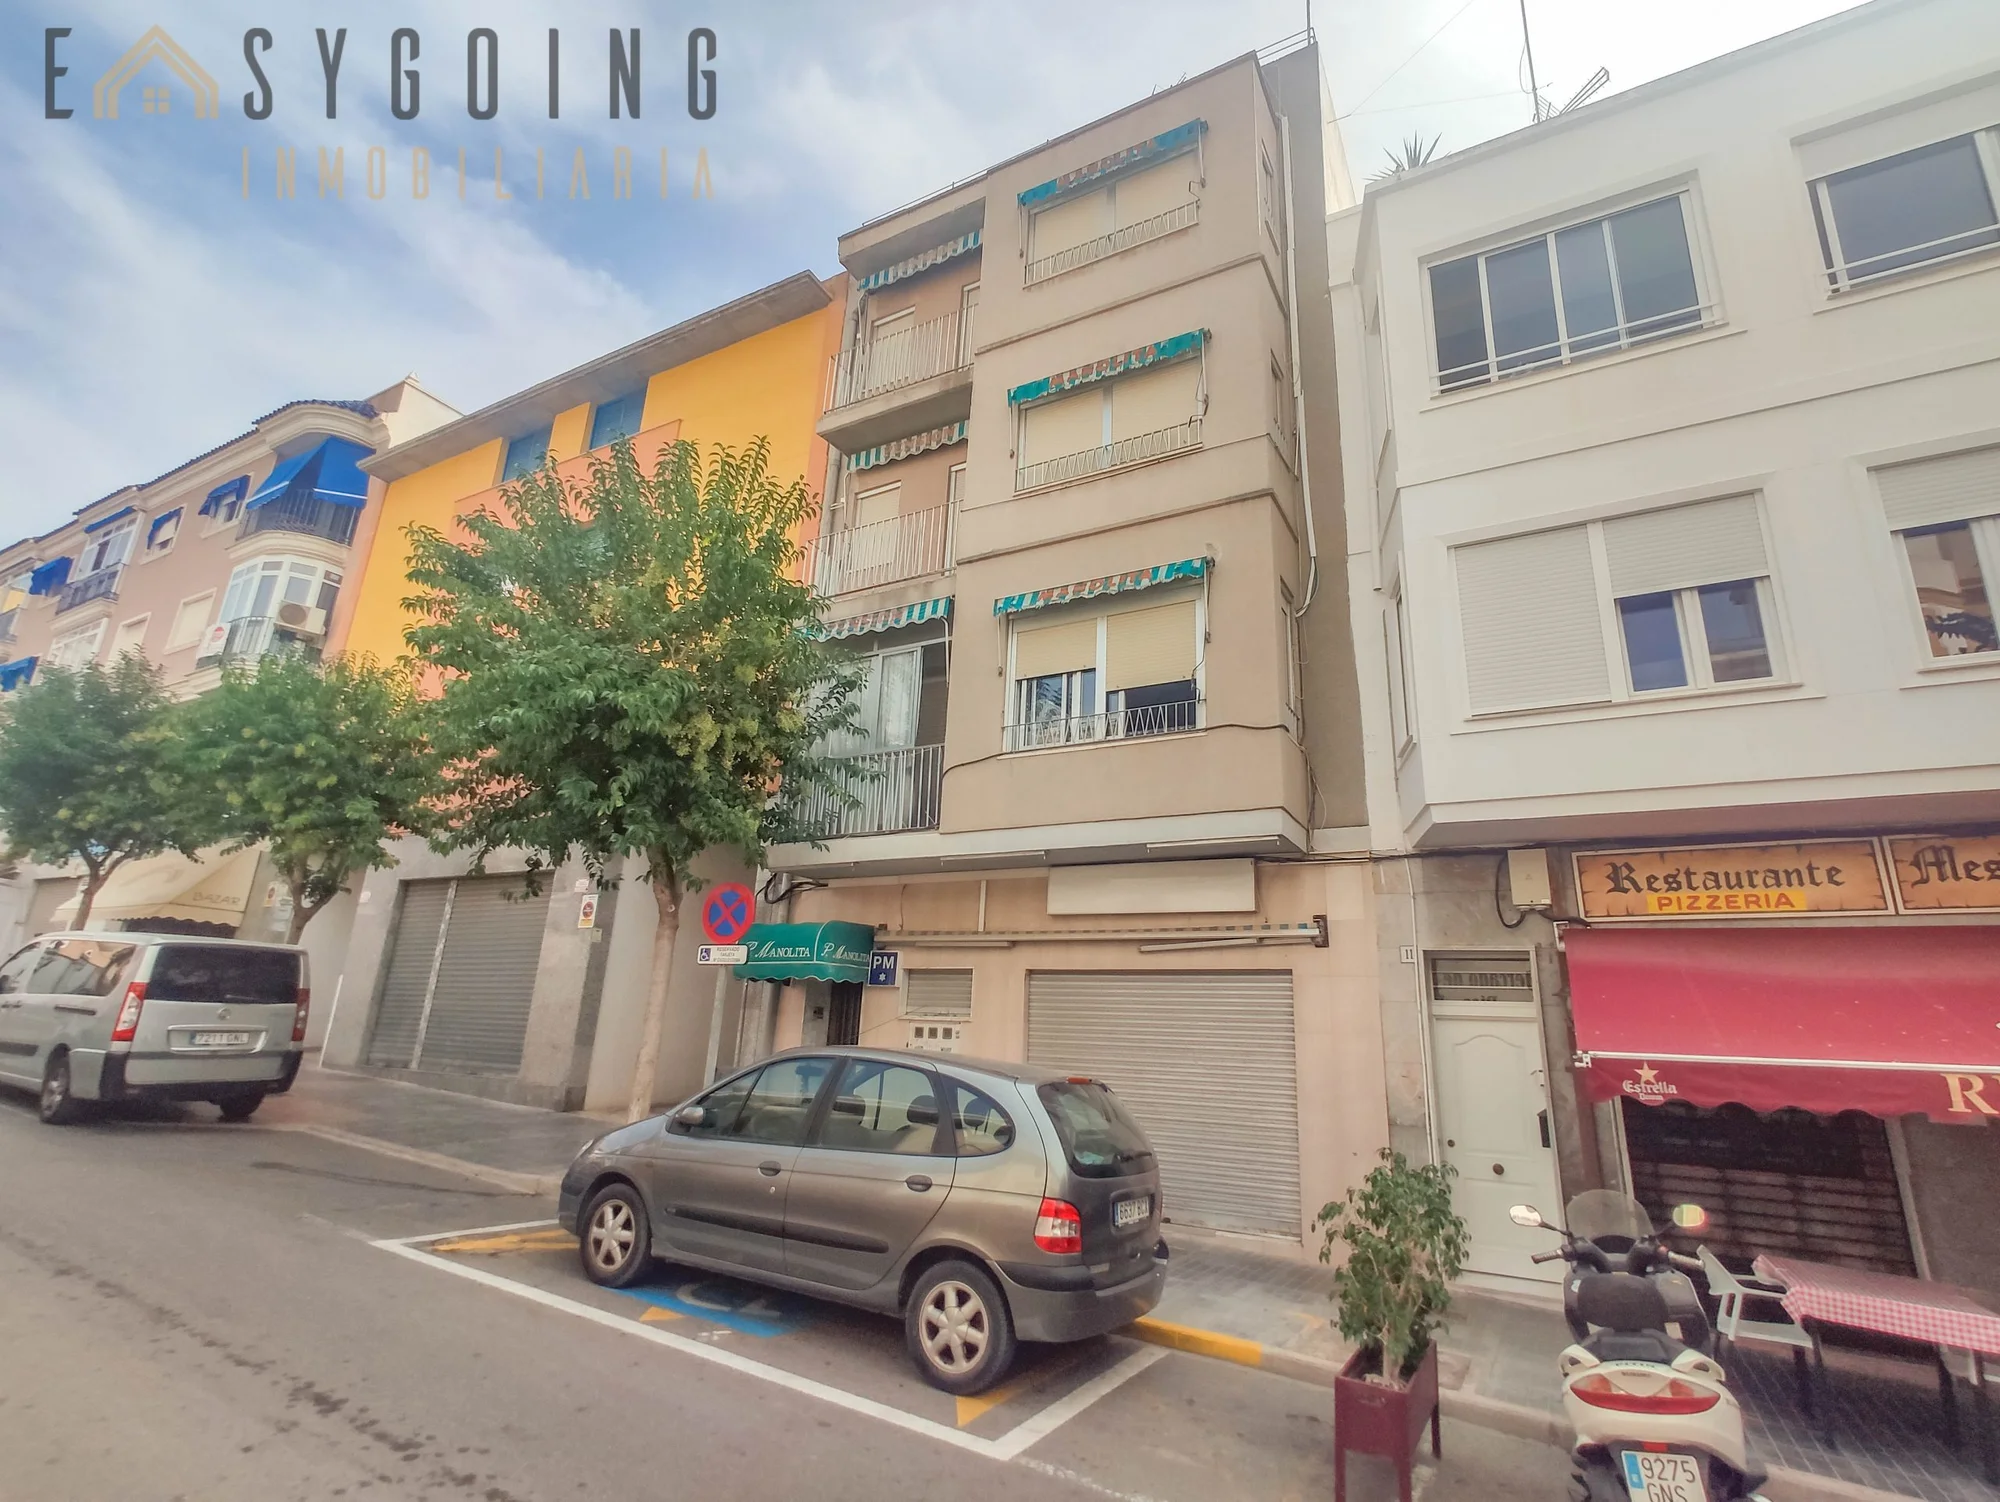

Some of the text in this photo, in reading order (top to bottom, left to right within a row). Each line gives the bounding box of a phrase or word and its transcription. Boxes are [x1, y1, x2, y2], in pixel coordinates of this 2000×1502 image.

[1605, 859, 1846, 895] Restaurante
[192, 891, 241, 905] BAZAR
[1656, 892, 1796, 912] PIZZERIA
[873, 955, 895, 969] PM
[1622, 1079, 1678, 1094] Estrella
[1641, 1457, 1696, 1484] 9275
[1646, 1482, 1689, 1502] GNS
